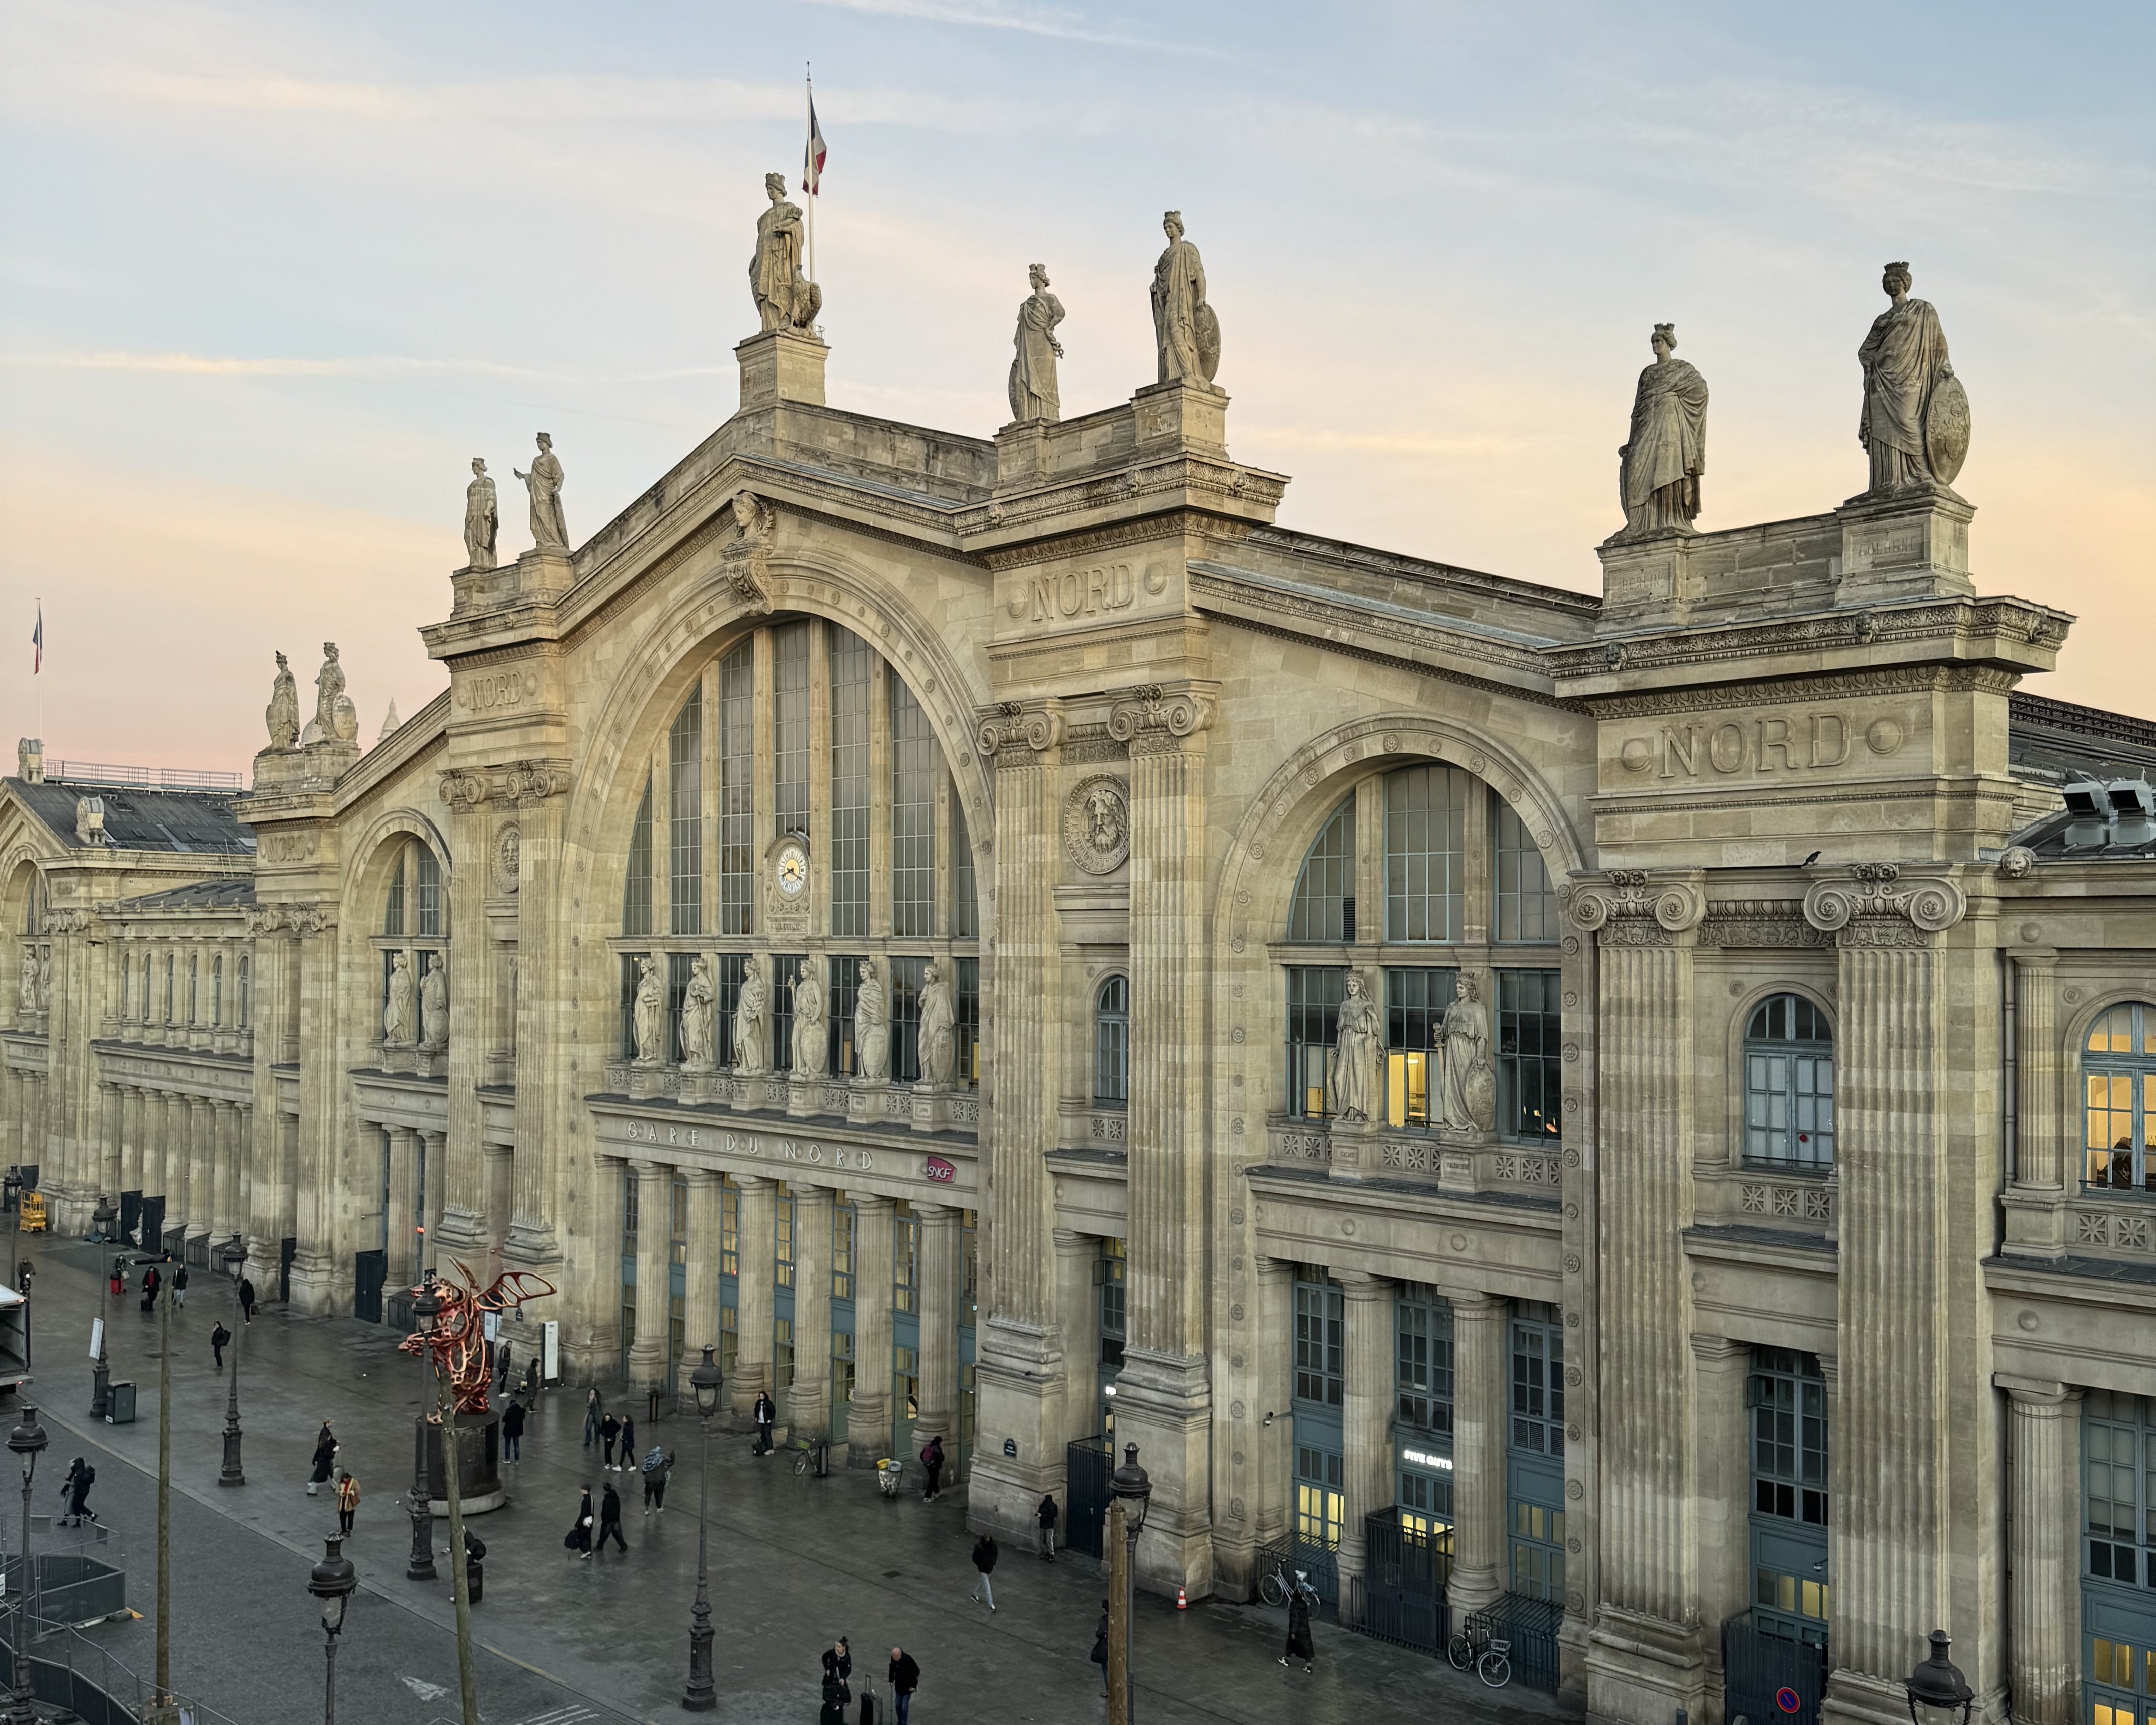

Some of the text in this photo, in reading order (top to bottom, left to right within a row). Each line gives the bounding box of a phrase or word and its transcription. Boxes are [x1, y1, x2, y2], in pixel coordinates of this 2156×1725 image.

[746, 367, 773, 390] PARIS
[1032, 561, 1135, 622] NORD
[1622, 573, 1659, 591] BERLIN
[469, 671, 523, 710] NORD
[1660, 711, 1852, 778] NORD
[267, 835, 305, 862] NORD
[627, 1121, 873, 1170] GARE DU NORD
[928, 1166, 952, 1178] SNCF
[1404, 1450, 1453, 1470] FIVE GUYS
